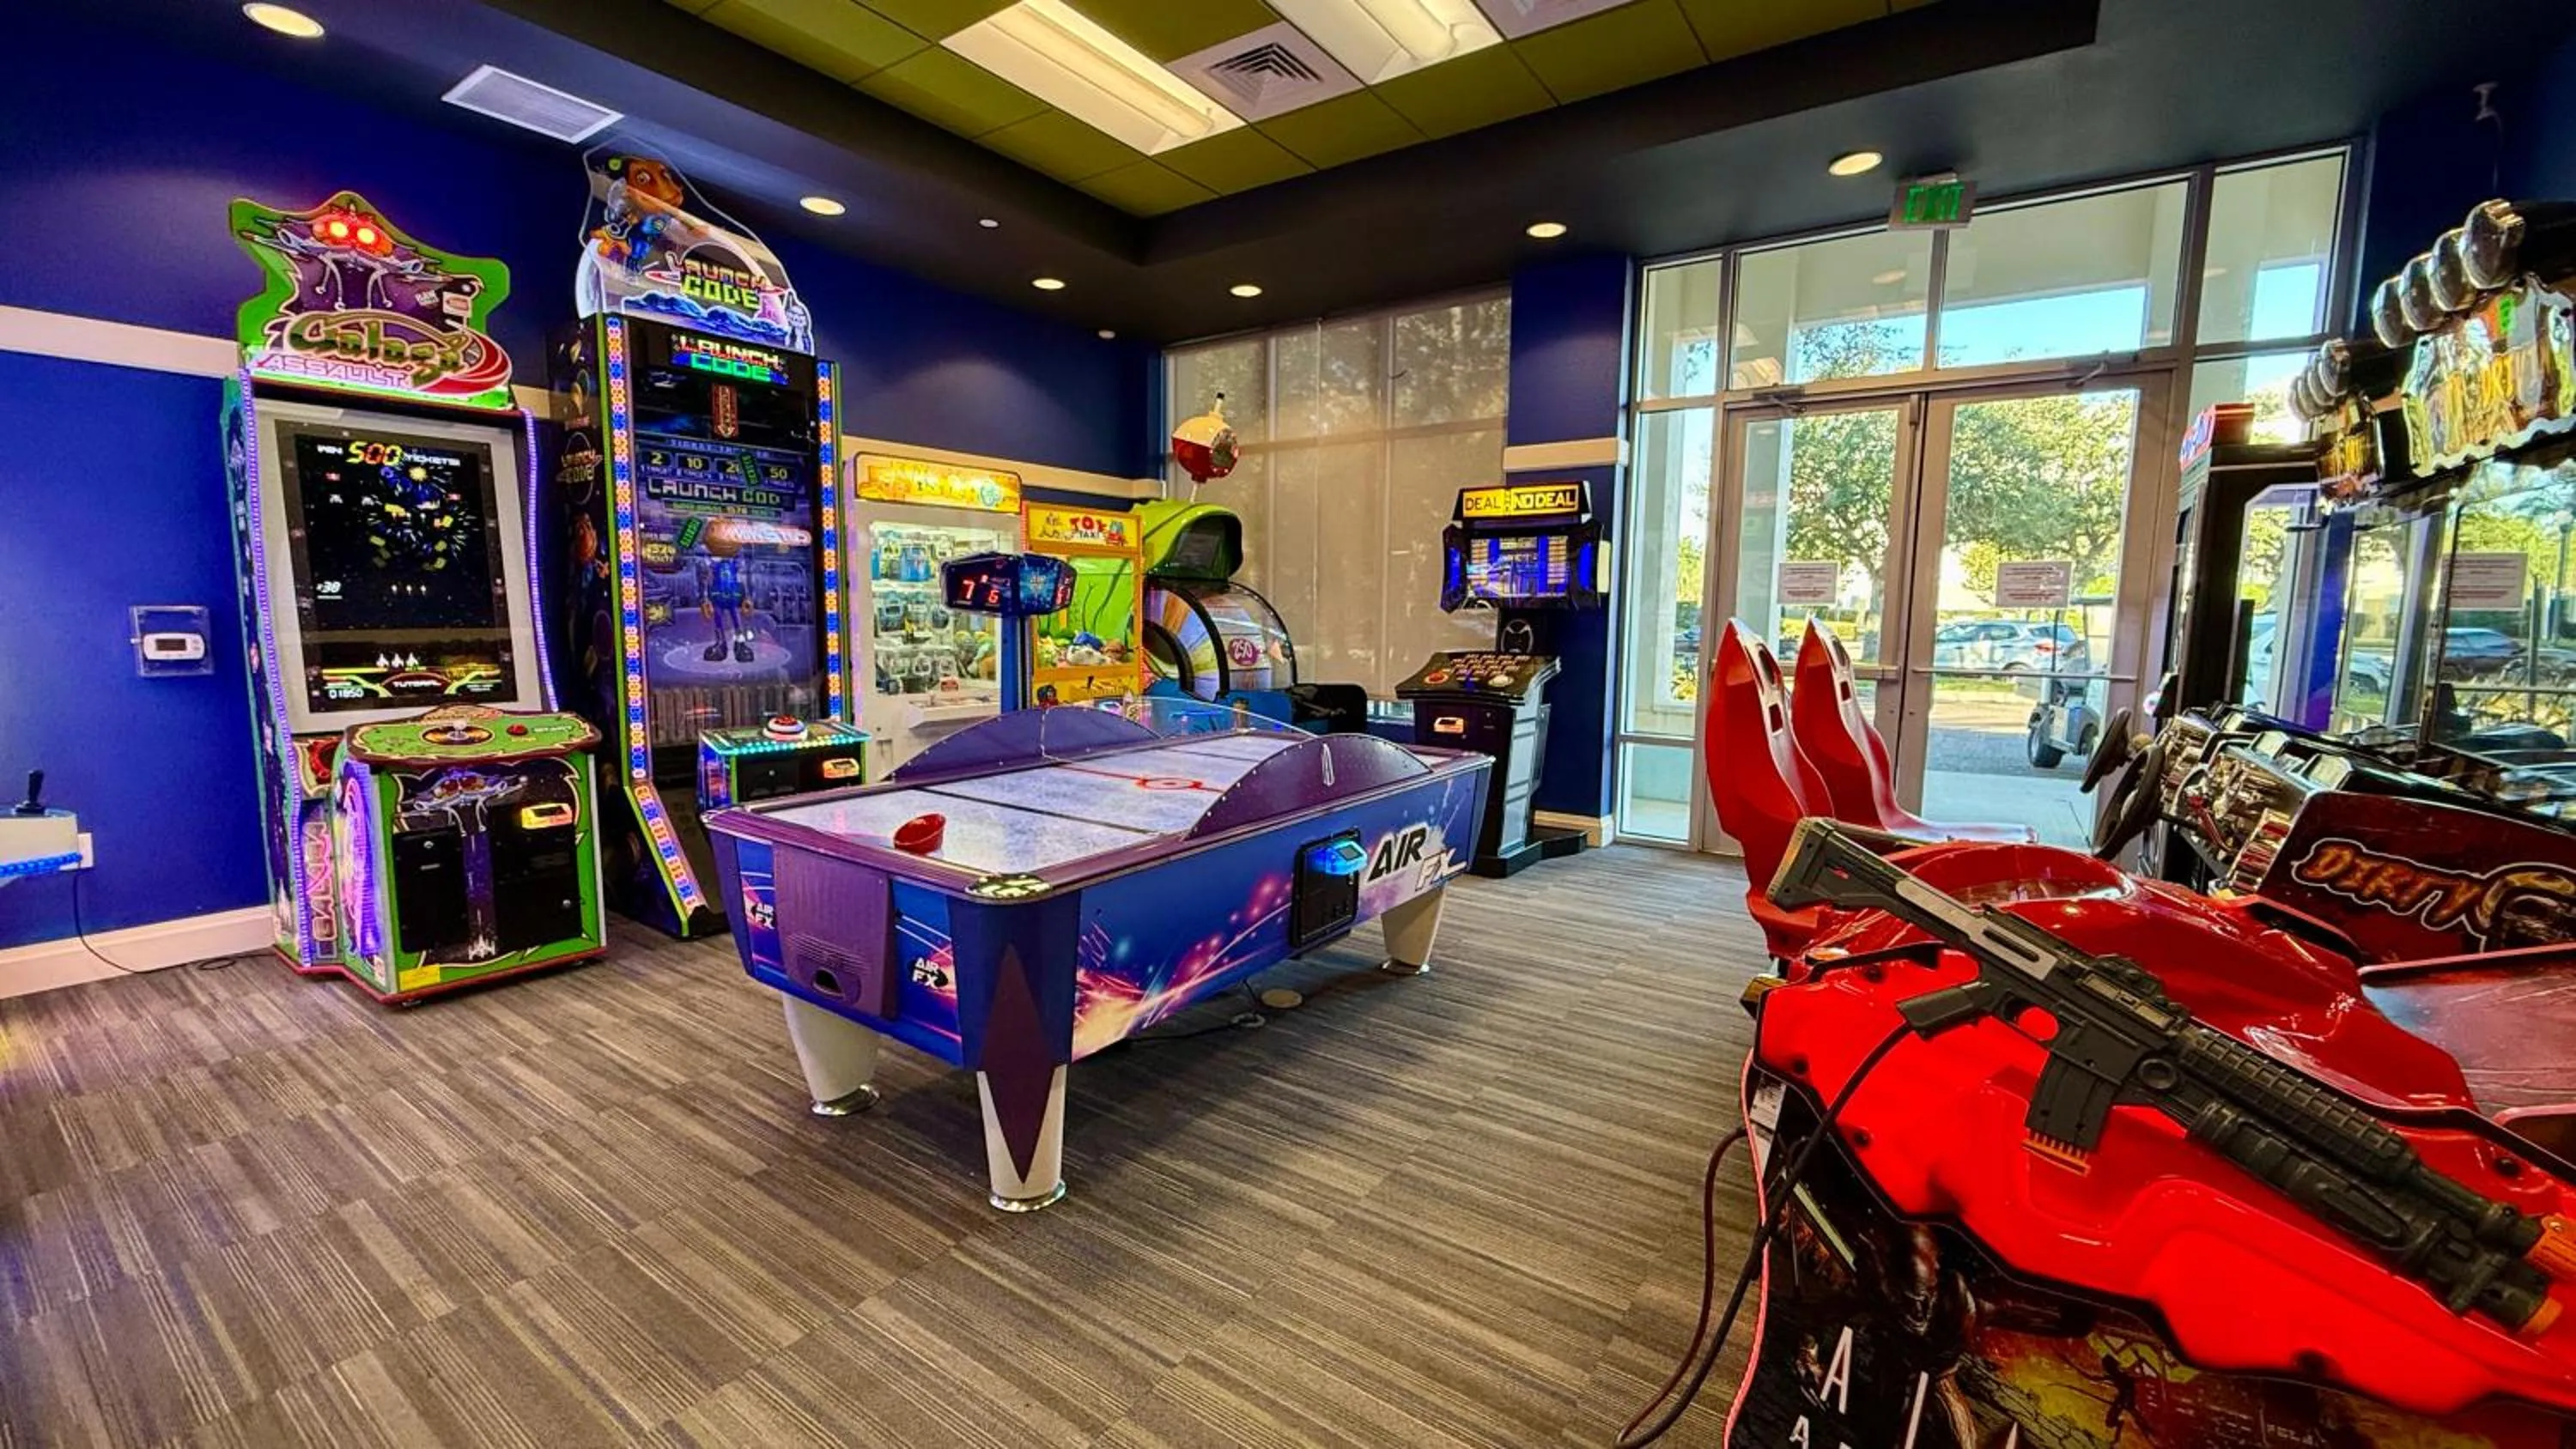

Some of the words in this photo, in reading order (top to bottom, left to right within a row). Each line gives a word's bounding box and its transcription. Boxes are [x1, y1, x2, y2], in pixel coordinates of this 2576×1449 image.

[682, 275, 762, 309] CODE
[680, 336, 781, 371] LAUNCH
[260, 354, 407, 386] ASSAULT
[690, 353, 772, 383] CODE
[345, 440, 403, 466] 500
[687, 457, 703, 470] 10
[647, 476, 737, 501] LAUNCH
[1514, 494, 1534, 509] NO
[1534, 491, 1575, 508] DEAL
[1465, 496, 1501, 511] DEAL
[961, 579, 976, 600] 7
[1367, 827, 1427, 882] AIR
[1414, 846, 1468, 892] FX
[914, 957, 939, 973] AIR
[912, 969, 939, 990] FX
